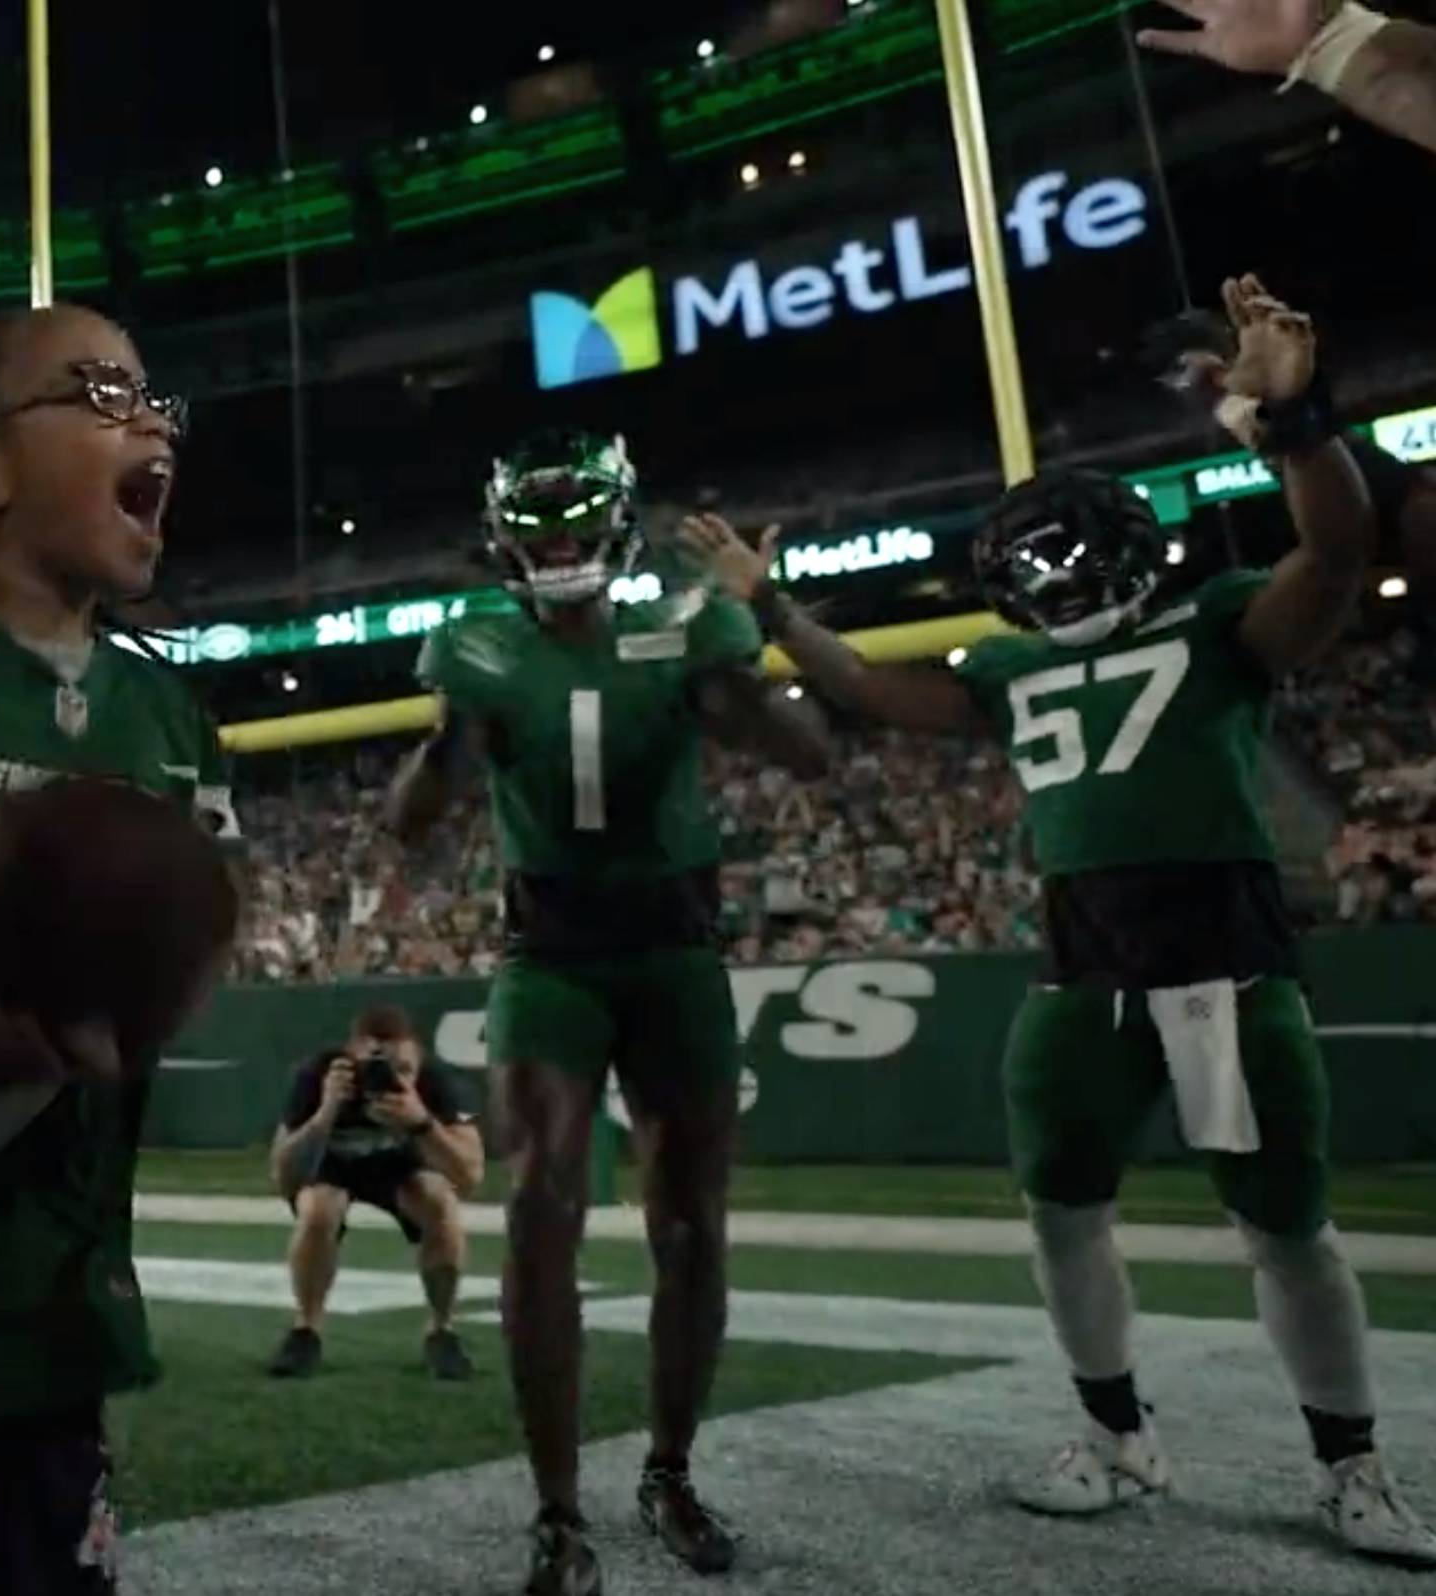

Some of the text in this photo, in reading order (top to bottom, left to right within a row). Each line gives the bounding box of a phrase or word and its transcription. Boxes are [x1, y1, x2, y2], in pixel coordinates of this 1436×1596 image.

[673, 171, 1147, 355] MetLfe
[784, 526, 934, 580] MetLife
[570, 689, 605, 830] 1
[1008, 638, 1191, 793] 57
